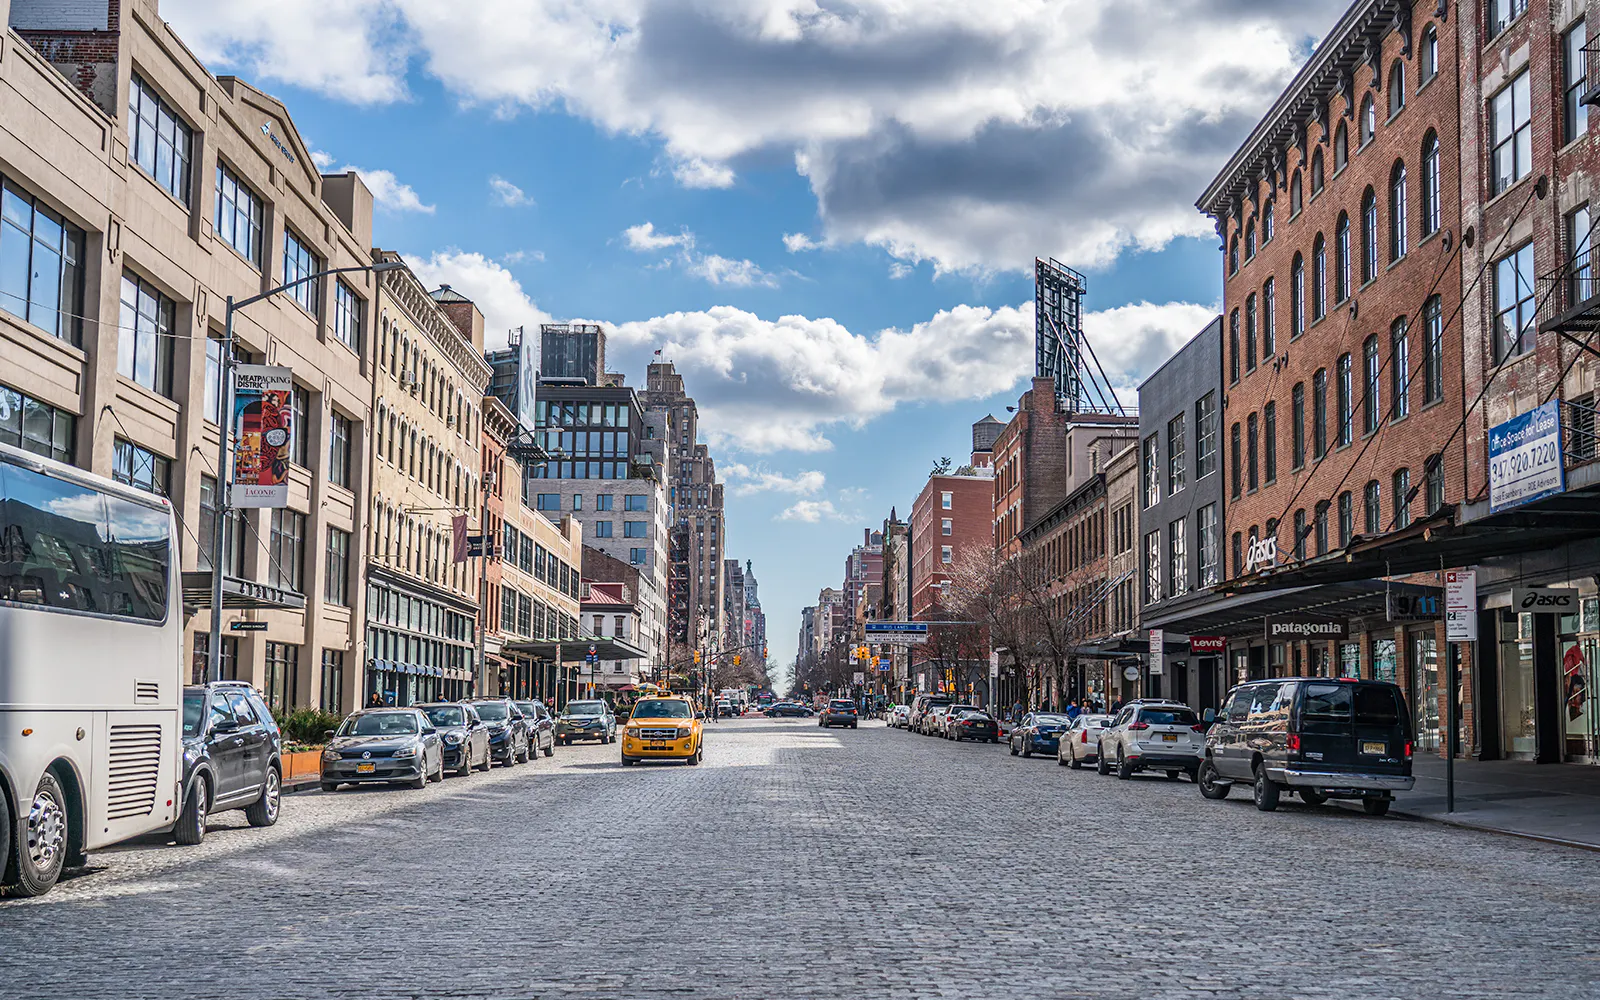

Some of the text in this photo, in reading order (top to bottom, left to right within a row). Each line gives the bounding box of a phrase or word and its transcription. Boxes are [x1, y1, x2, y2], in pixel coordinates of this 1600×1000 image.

[238, 375, 291, 384] MEATPACKING
[238, 381, 269, 389] DISTRICT
[1507, 430, 1524, 446] Space
[1525, 424, 1535, 437] for
[1536, 417, 1555, 433] Lease
[1492, 441, 1556, 483] 347.920.7220
[1537, 477, 1558, 488] Advisors
[1398, 596, 1436, 614] 9/11
[1449, 611, 1454, 620] 2
[1271, 622, 1342, 635] patagonia
